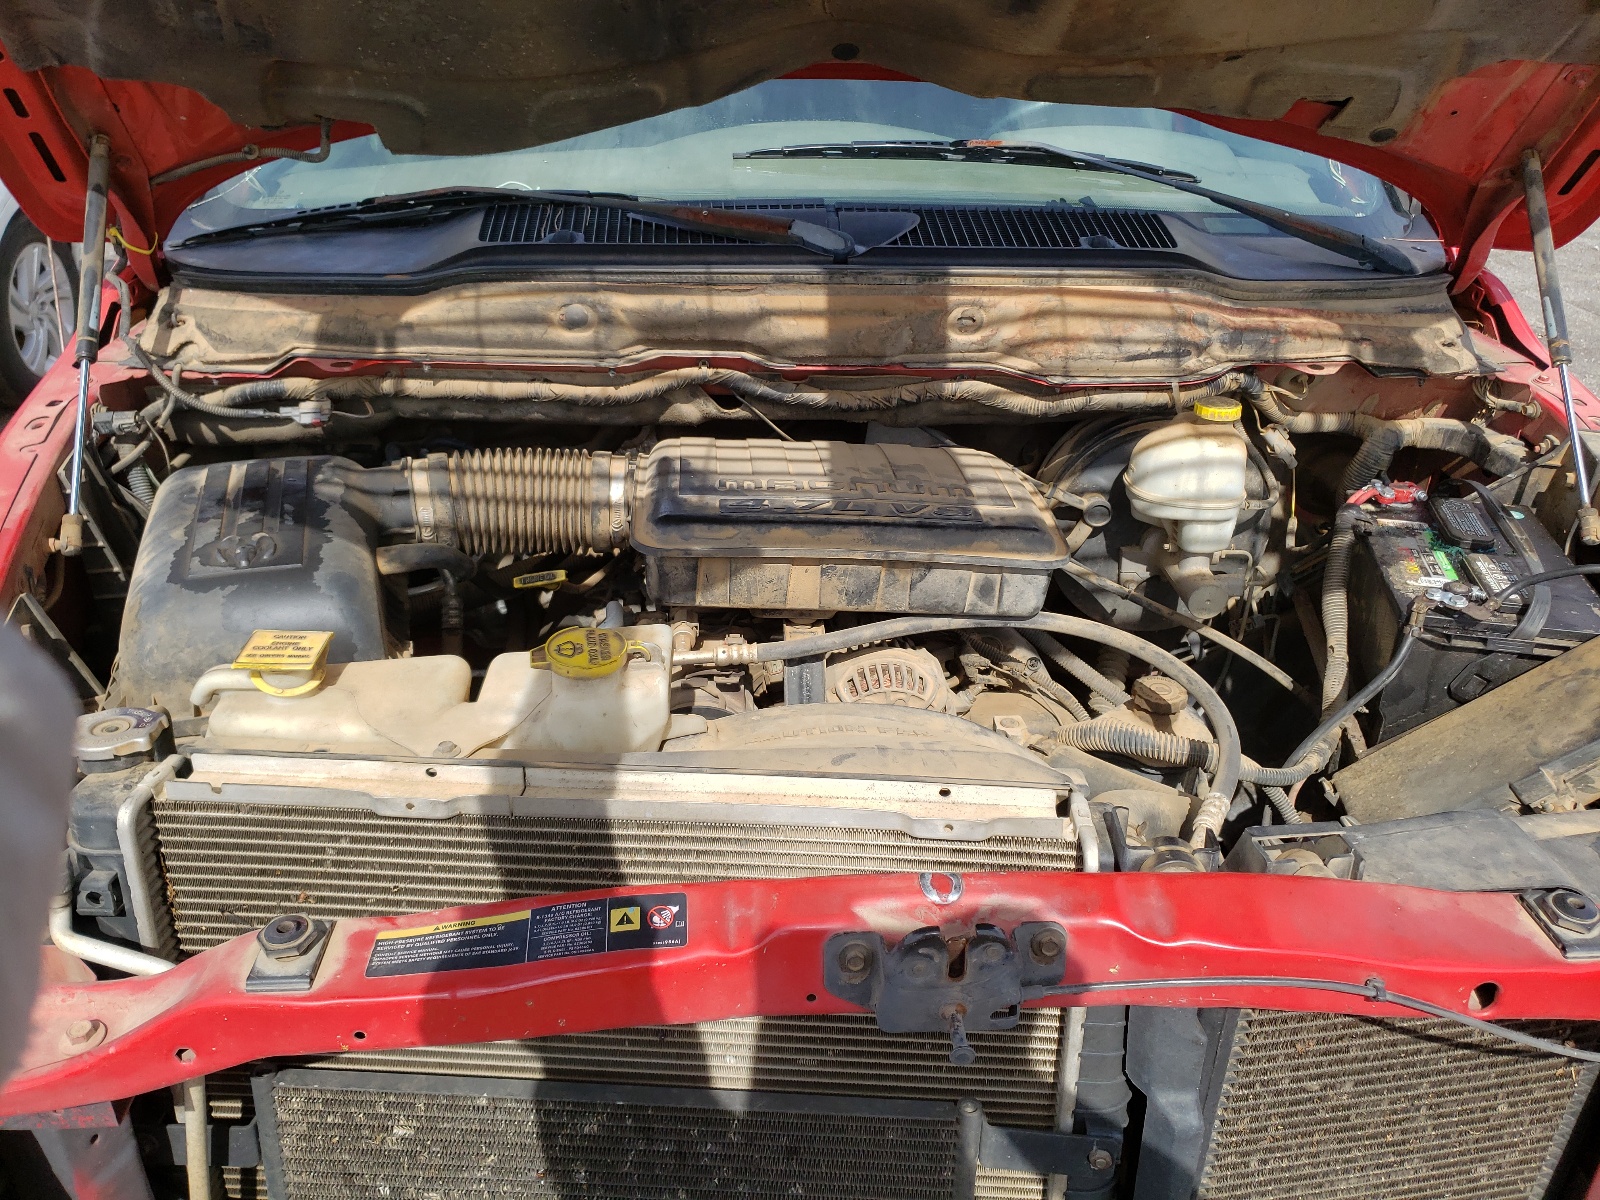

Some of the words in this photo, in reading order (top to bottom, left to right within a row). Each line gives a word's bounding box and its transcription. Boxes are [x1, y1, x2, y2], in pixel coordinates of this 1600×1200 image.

[598, 632, 612, 661] WASHER
[552, 902, 587, 911] ATTENTION
[566, 906, 602, 915] REFRIGERANT
[442, 920, 476, 930] WARNING
